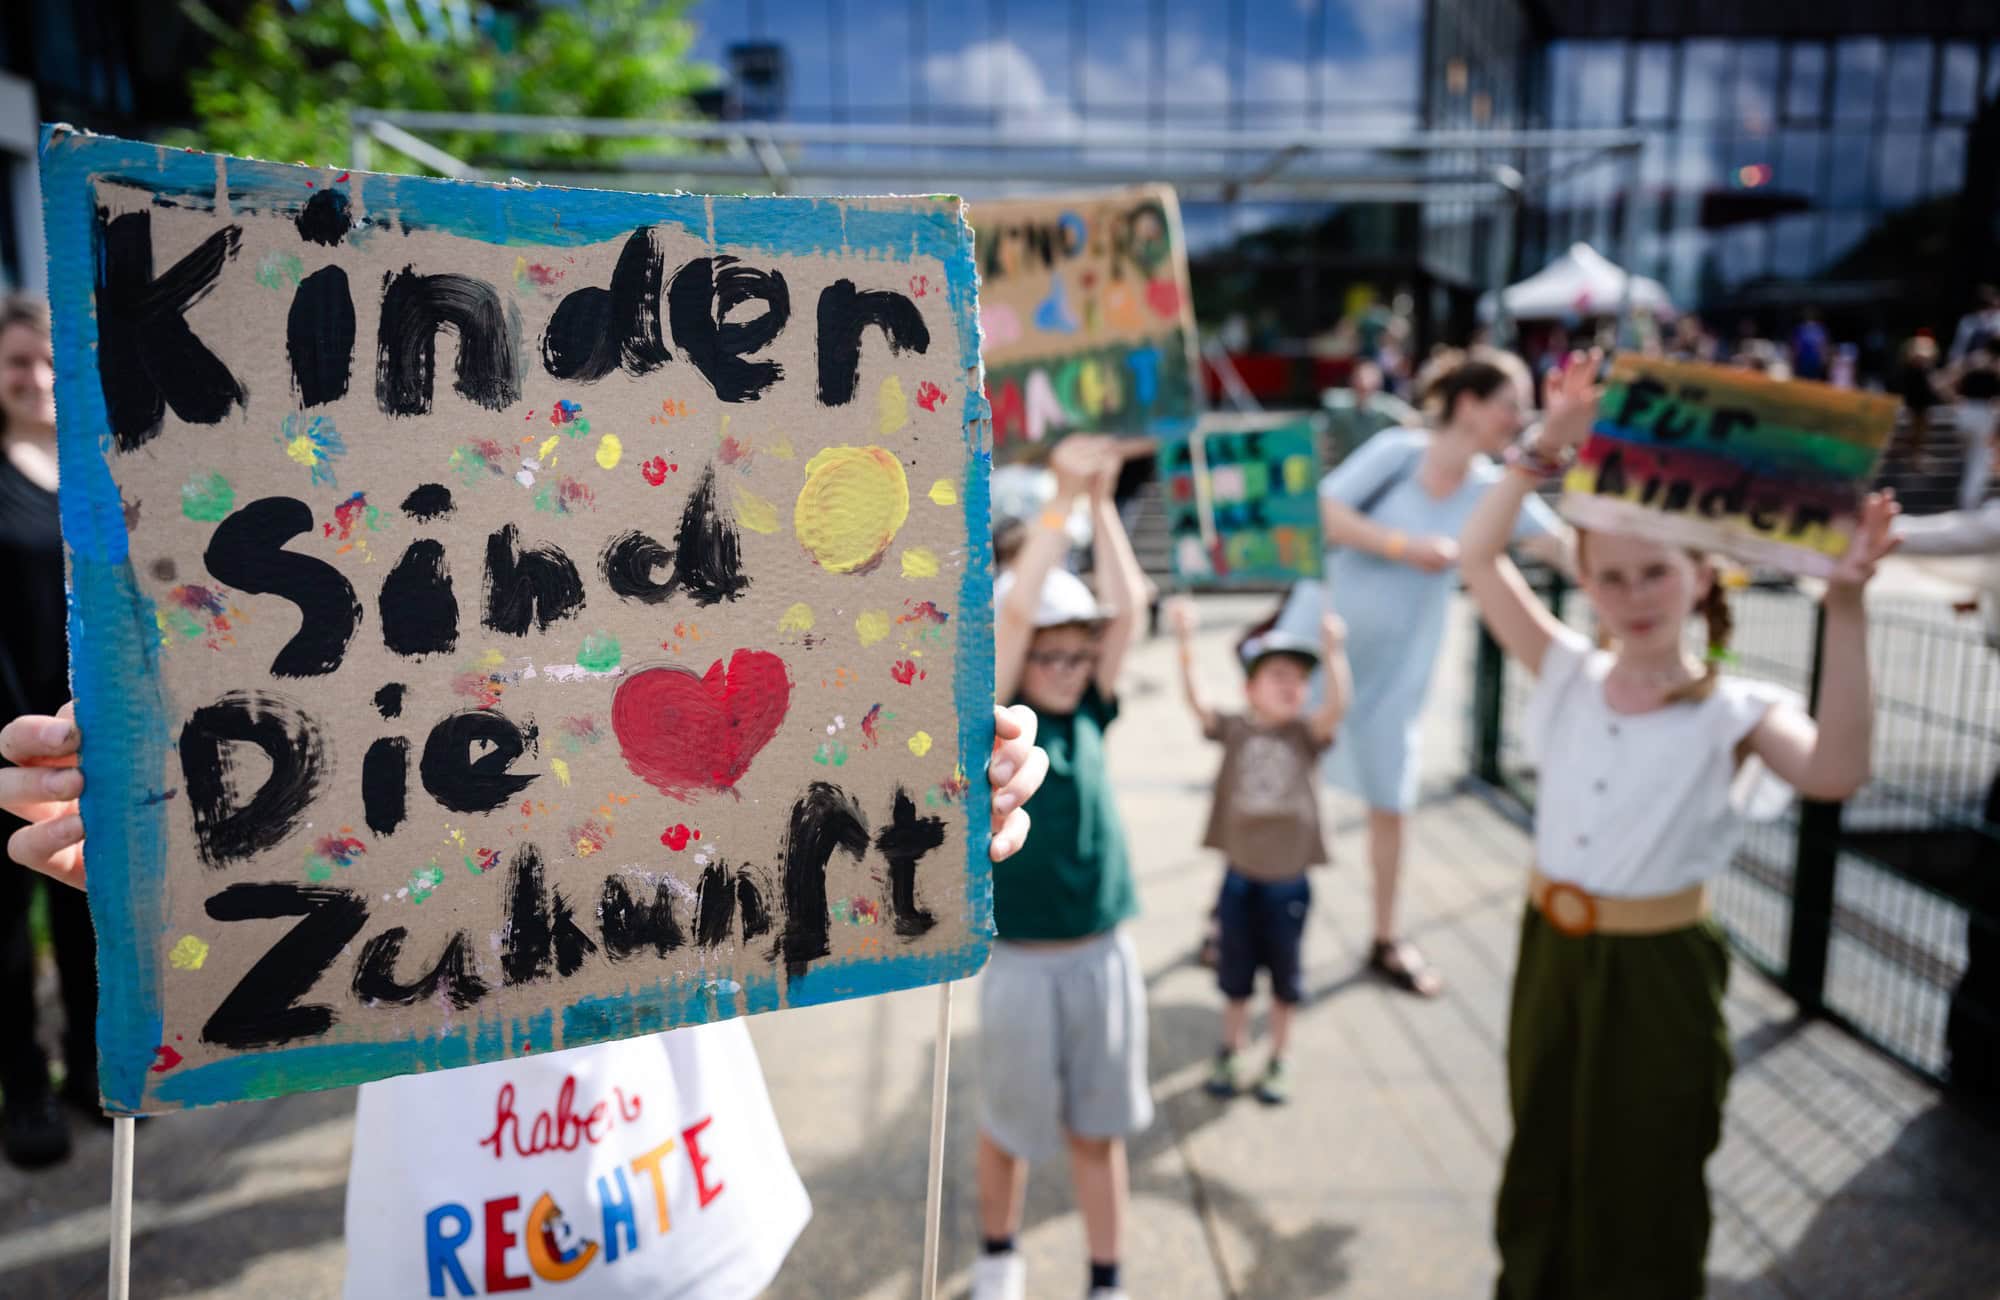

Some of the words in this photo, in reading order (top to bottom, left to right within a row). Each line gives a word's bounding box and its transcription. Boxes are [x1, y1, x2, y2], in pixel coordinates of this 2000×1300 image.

[95, 186, 932, 453] Kinder
[1616, 376, 1757, 440] Für
[203, 462, 751, 679] Sind
[179, 681, 541, 869] Die
[200, 780, 948, 1049] Zukunft
[424, 1116, 725, 1299] RECHTE
